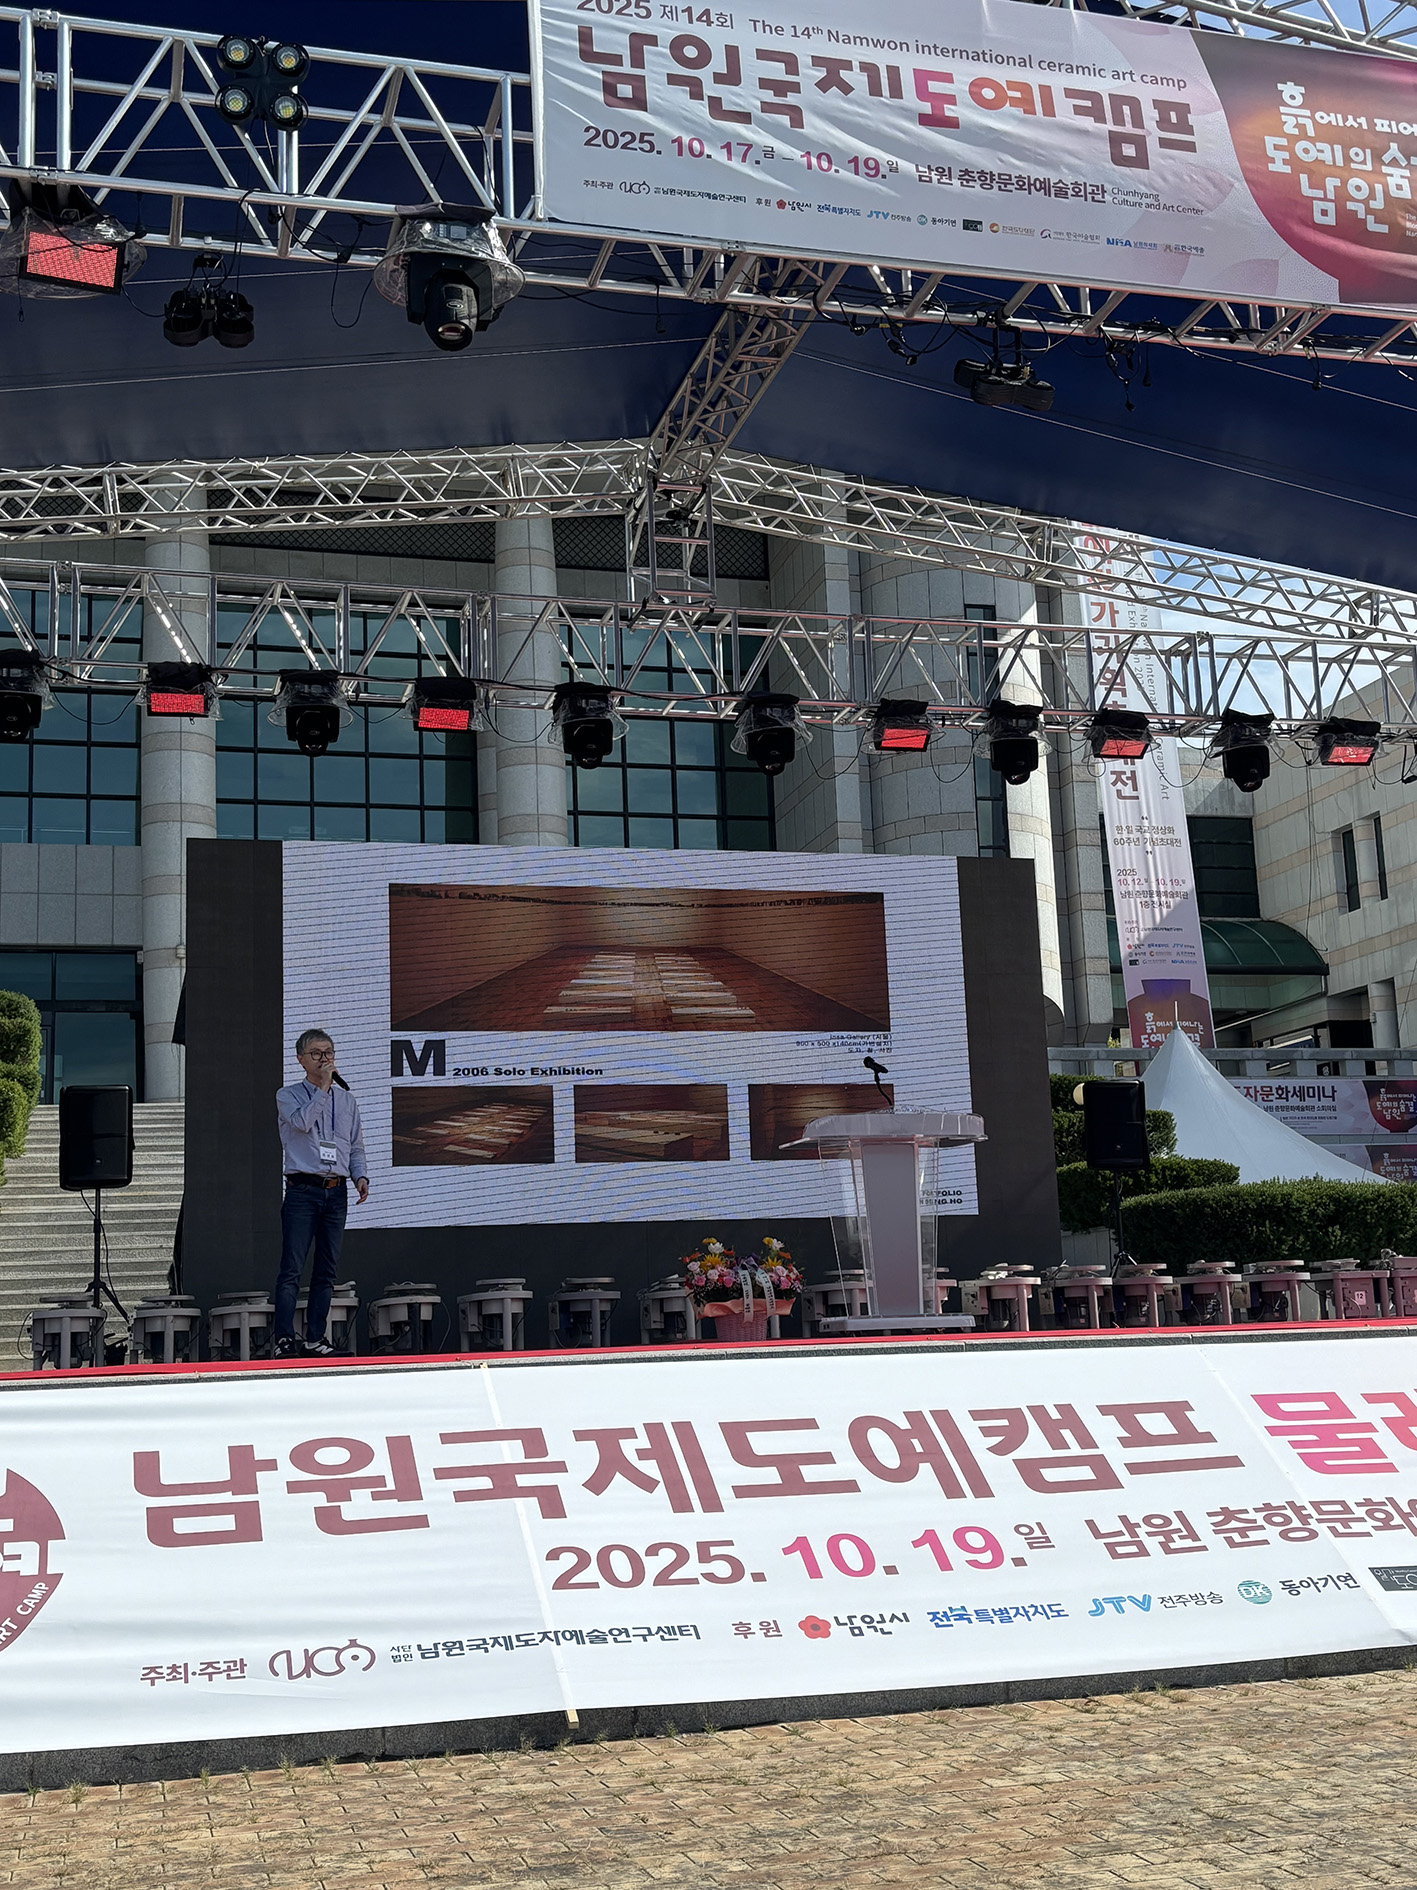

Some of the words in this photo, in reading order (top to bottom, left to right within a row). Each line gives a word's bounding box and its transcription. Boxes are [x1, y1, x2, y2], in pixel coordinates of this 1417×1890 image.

[577, 0, 652, 20] 2025
[660, 4, 735, 30] 제14회
[748, 19, 785, 37] The
[790, 25, 824, 41] 14th
[827, 28, 910, 53] Namwon
[915, 39, 1034, 69] international
[1038, 58, 1106, 79] ceramic
[1111, 68, 1137, 83] art
[1140, 72, 1188, 92] camp
[578, 25, 1198, 171] 남원국제도예캠프
[1276, 81, 1368, 137] 흙에서
[583, 125, 663, 155] 2025.
[671, 135, 713, 159] 10.
[800, 150, 840, 174] 10.
[914, 163, 954, 187] 남원
[957, 167, 1107, 204] 춘향문화예술회관
[1264, 136, 1373, 174] 도예의
[755, 197, 772, 207] 후원
[1111, 187, 1160, 202] Chunhyang
[1111, 197, 1144, 209] Culture
[1144, 202, 1161, 211] and
[1162, 203, 1175, 213] Art
[1176, 204, 1204, 216] Center
[1299, 173, 1389, 234] 남원
[866, 209, 890, 221] JTV
[1160, 783, 1170, 801] Art
[1113, 837, 1141, 847] 60주년
[1151, 826, 1175, 835] 정상화
[1116, 868, 1138, 877] 2025
[1118, 878, 1130, 887] 10.
[1156, 878, 1168, 887] 10.
[1120, 890, 1134, 900] 남원
[1144, 1012, 1173, 1034] 흙에서
[390, 1039, 447, 1077] M
[452, 1066, 490, 1077] 2006
[493, 1066, 526, 1077] Solo
[529, 1065, 604, 1077] Exhibition
[1234, 1085, 1338, 1103] 자문화세미나
[1383, 1108, 1402, 1120] 남원
[133, 1399, 1246, 1549] 남원국제도예캠프
[545, 1539, 767, 1593] 2025.
[781, 1532, 900, 1581] 10.
[1084, 1510, 1210, 1561] 남원
[1278, 1571, 1361, 1597] 동아기연
[16, 1581, 50, 1616] CAMP
[1088, 1593, 1152, 1617] JTV
[1157, 1590, 1225, 1610] 전주방송
[834, 1611, 911, 1637] 남원시
[926, 1602, 1070, 1629] 전북특별자치도
[416, 1623, 702, 1660] 남원국제도자예술연구센터
[731, 1619, 783, 1640] 후원
[140, 1657, 248, 1687] 주최·주관
